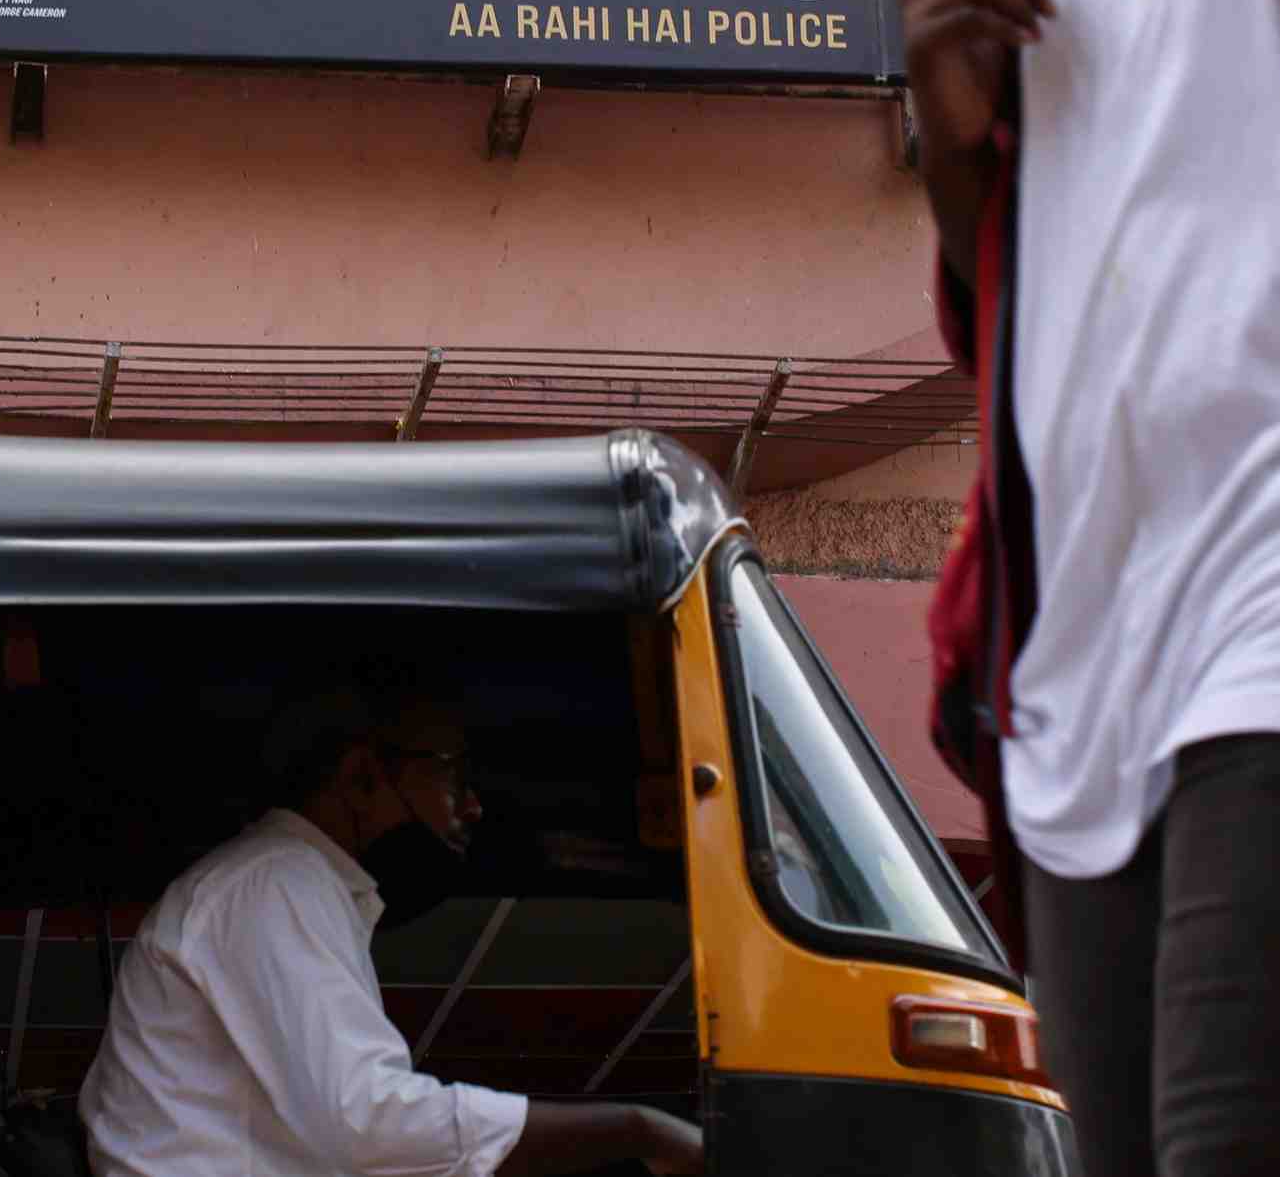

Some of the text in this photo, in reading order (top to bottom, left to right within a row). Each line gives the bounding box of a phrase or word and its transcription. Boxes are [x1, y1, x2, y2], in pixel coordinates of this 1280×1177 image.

[449, 2, 848, 49] AA RAHI HAI POLICE
